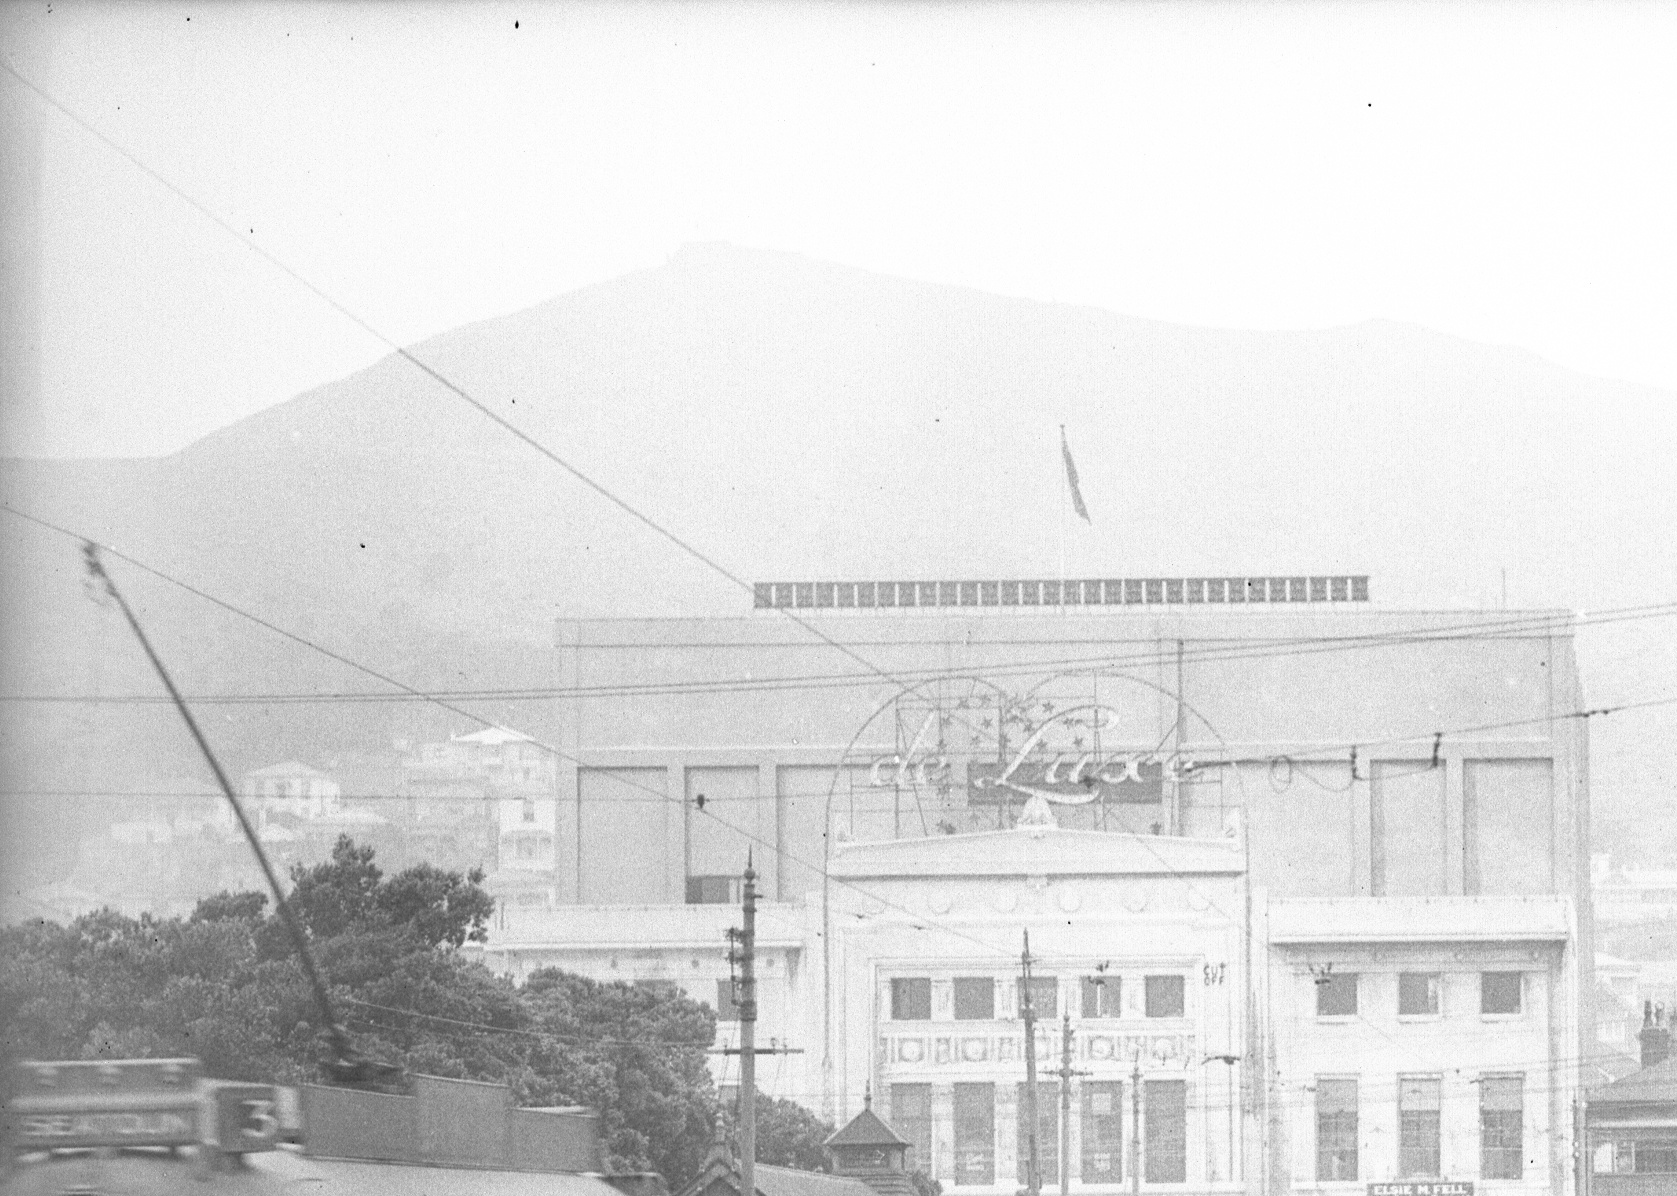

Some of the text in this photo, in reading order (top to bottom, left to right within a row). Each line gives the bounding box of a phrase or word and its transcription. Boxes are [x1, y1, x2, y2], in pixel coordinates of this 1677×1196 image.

[870, 704, 1197, 805] de Luxe
[1203, 962, 1227, 976] CUT
[1203, 975, 1225, 987] OFF
[240, 1100, 279, 1139] 3
[1373, 1185, 1412, 1195] ELSIE
[1433, 1184, 1467, 1194] FELL
